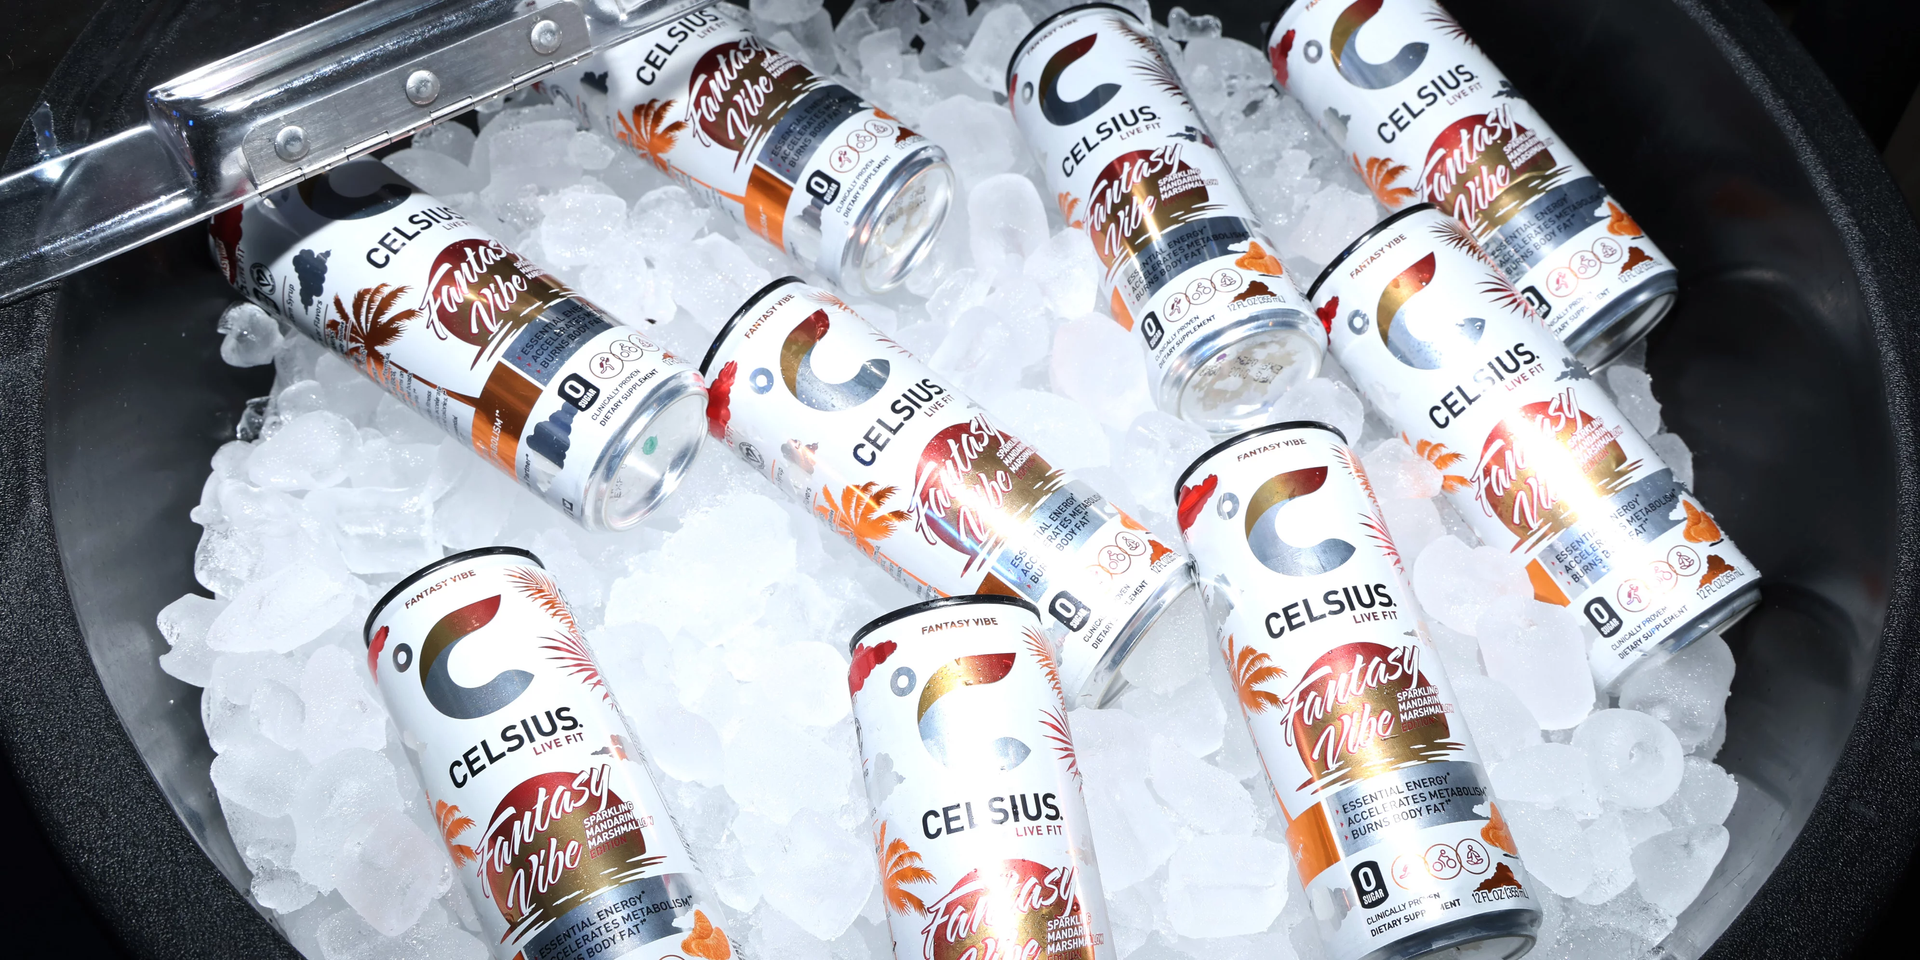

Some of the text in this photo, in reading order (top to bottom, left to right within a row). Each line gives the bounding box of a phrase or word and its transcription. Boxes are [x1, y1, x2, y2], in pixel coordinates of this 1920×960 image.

[685, 35, 772, 148] Fantasy
[1446, 82, 1483, 106] LIVE FIT
[726, 75, 773, 141] Vibe
[771, 113, 807, 157] ESSENTIAL
[789, 117, 829, 168] BURNS BODY
[1120, 122, 1162, 141] LIVE FIT
[1415, 103, 1517, 203] Fantasy
[810, 176, 828, 194] 0
[823, 182, 839, 202] SUGAR
[835, 159, 875, 213] CLINICALLY PROVEN
[843, 155, 891, 218] DIETARY SUPPLEMENT
[1082, 143, 1183, 238] Fantasy
[1158, 168, 1201, 187] SPARKLING
[1159, 175, 1201, 195] MANDARIN
[1453, 164, 1510, 230] Vibe
[1104, 195, 1157, 258] Vibe
[1350, 233, 1408, 279] FANTASY VIBE
[1499, 219, 1556, 268] ACCELERATES
[1504, 232, 1558, 276] BURNS BODY
[1131, 247, 1188, 294] ACCELERATES
[1136, 257, 1184, 302] BURNS BODY
[470, 274, 527, 334] Vibe
[745, 293, 795, 339] FANTASY VIBE
[1227, 302, 1237, 312] 12
[521, 317, 565, 355] ESSENTIAL
[532, 316, 586, 362] ACCELERATES
[1144, 317, 1157, 335] 0
[1155, 315, 1200, 361] CLINICALLY PROVEN
[540, 325, 591, 369] BURNS BODY
[1159, 346, 1177, 369] DIETARY
[1175, 315, 1216, 348] SUPPLEMENT
[564, 379, 586, 399] 0
[1504, 362, 1546, 392] LIVE FIT
[577, 387, 597, 409] SUGAR
[591, 368, 641, 421] CLINICALLY PROVEN
[599, 368, 659, 426] DIETARY SUPPLEMENT
[924, 393, 955, 417] LIVE FIT
[1567, 416, 1604, 448] SPARKLING
[1237, 437, 1307, 462] FANTASY VIBE
[1581, 450, 1609, 474] EDITION
[1055, 528, 1078, 552] BODY
[1571, 553, 1602, 583] BURNS
[404, 569, 477, 610] FANTASY VIBE
[1697, 591, 1706, 600] 12
[1706, 585, 1717, 594] FL
[1055, 597, 1076, 618] 0
[1265, 583, 1398, 639] CELSIUS.
[1353, 610, 1398, 624] LIVE FIT
[1590, 602, 1609, 623] 0
[921, 617, 998, 635] FANTASY VIBE
[1600, 618, 1620, 635] SUGAR
[1611, 606, 1669, 651] CLINICALLY PROVEN
[1618, 604, 1690, 659] DIETARY SUPPLEMENT
[1280, 645, 1421, 747] Fantasy
[1397, 685, 1439, 701] SPARKLING
[1398, 696, 1440, 711] MANDARIN
[1311, 702, 1395, 771] Vibe
[1401, 717, 1436, 733] EDITION
[449, 706, 584, 789] CELSIUS.
[532, 732, 585, 756] LIVE FIT
[583, 801, 633, 828] SPARKLING
[1342, 785, 1405, 814] ESSENTIAL
[1347, 795, 1427, 827] ACCELERATES
[475, 763, 611, 899] Fantasy
[586, 811, 635, 839] MANDARIN
[588, 815, 654, 850] MARSHMALLOW
[1015, 825, 1062, 838] LIVE FIT
[1351, 809, 1424, 840] BURNS BODY
[590, 835, 627, 860] EDITION
[506, 838, 583, 917] Vibe
[1358, 866, 1376, 892] 0
[1362, 889, 1385, 905] SUGAR
[1471, 893, 1481, 904] 12
[1481, 891, 1492, 903] FL
[1492, 890, 1503, 901] OZ
[1366, 903, 1408, 926] CLINICALLY
[1370, 917, 1402, 937] DIETARY
[539, 917, 596, 959] ESSENTIAL
[585, 934, 617, 958] BODY
